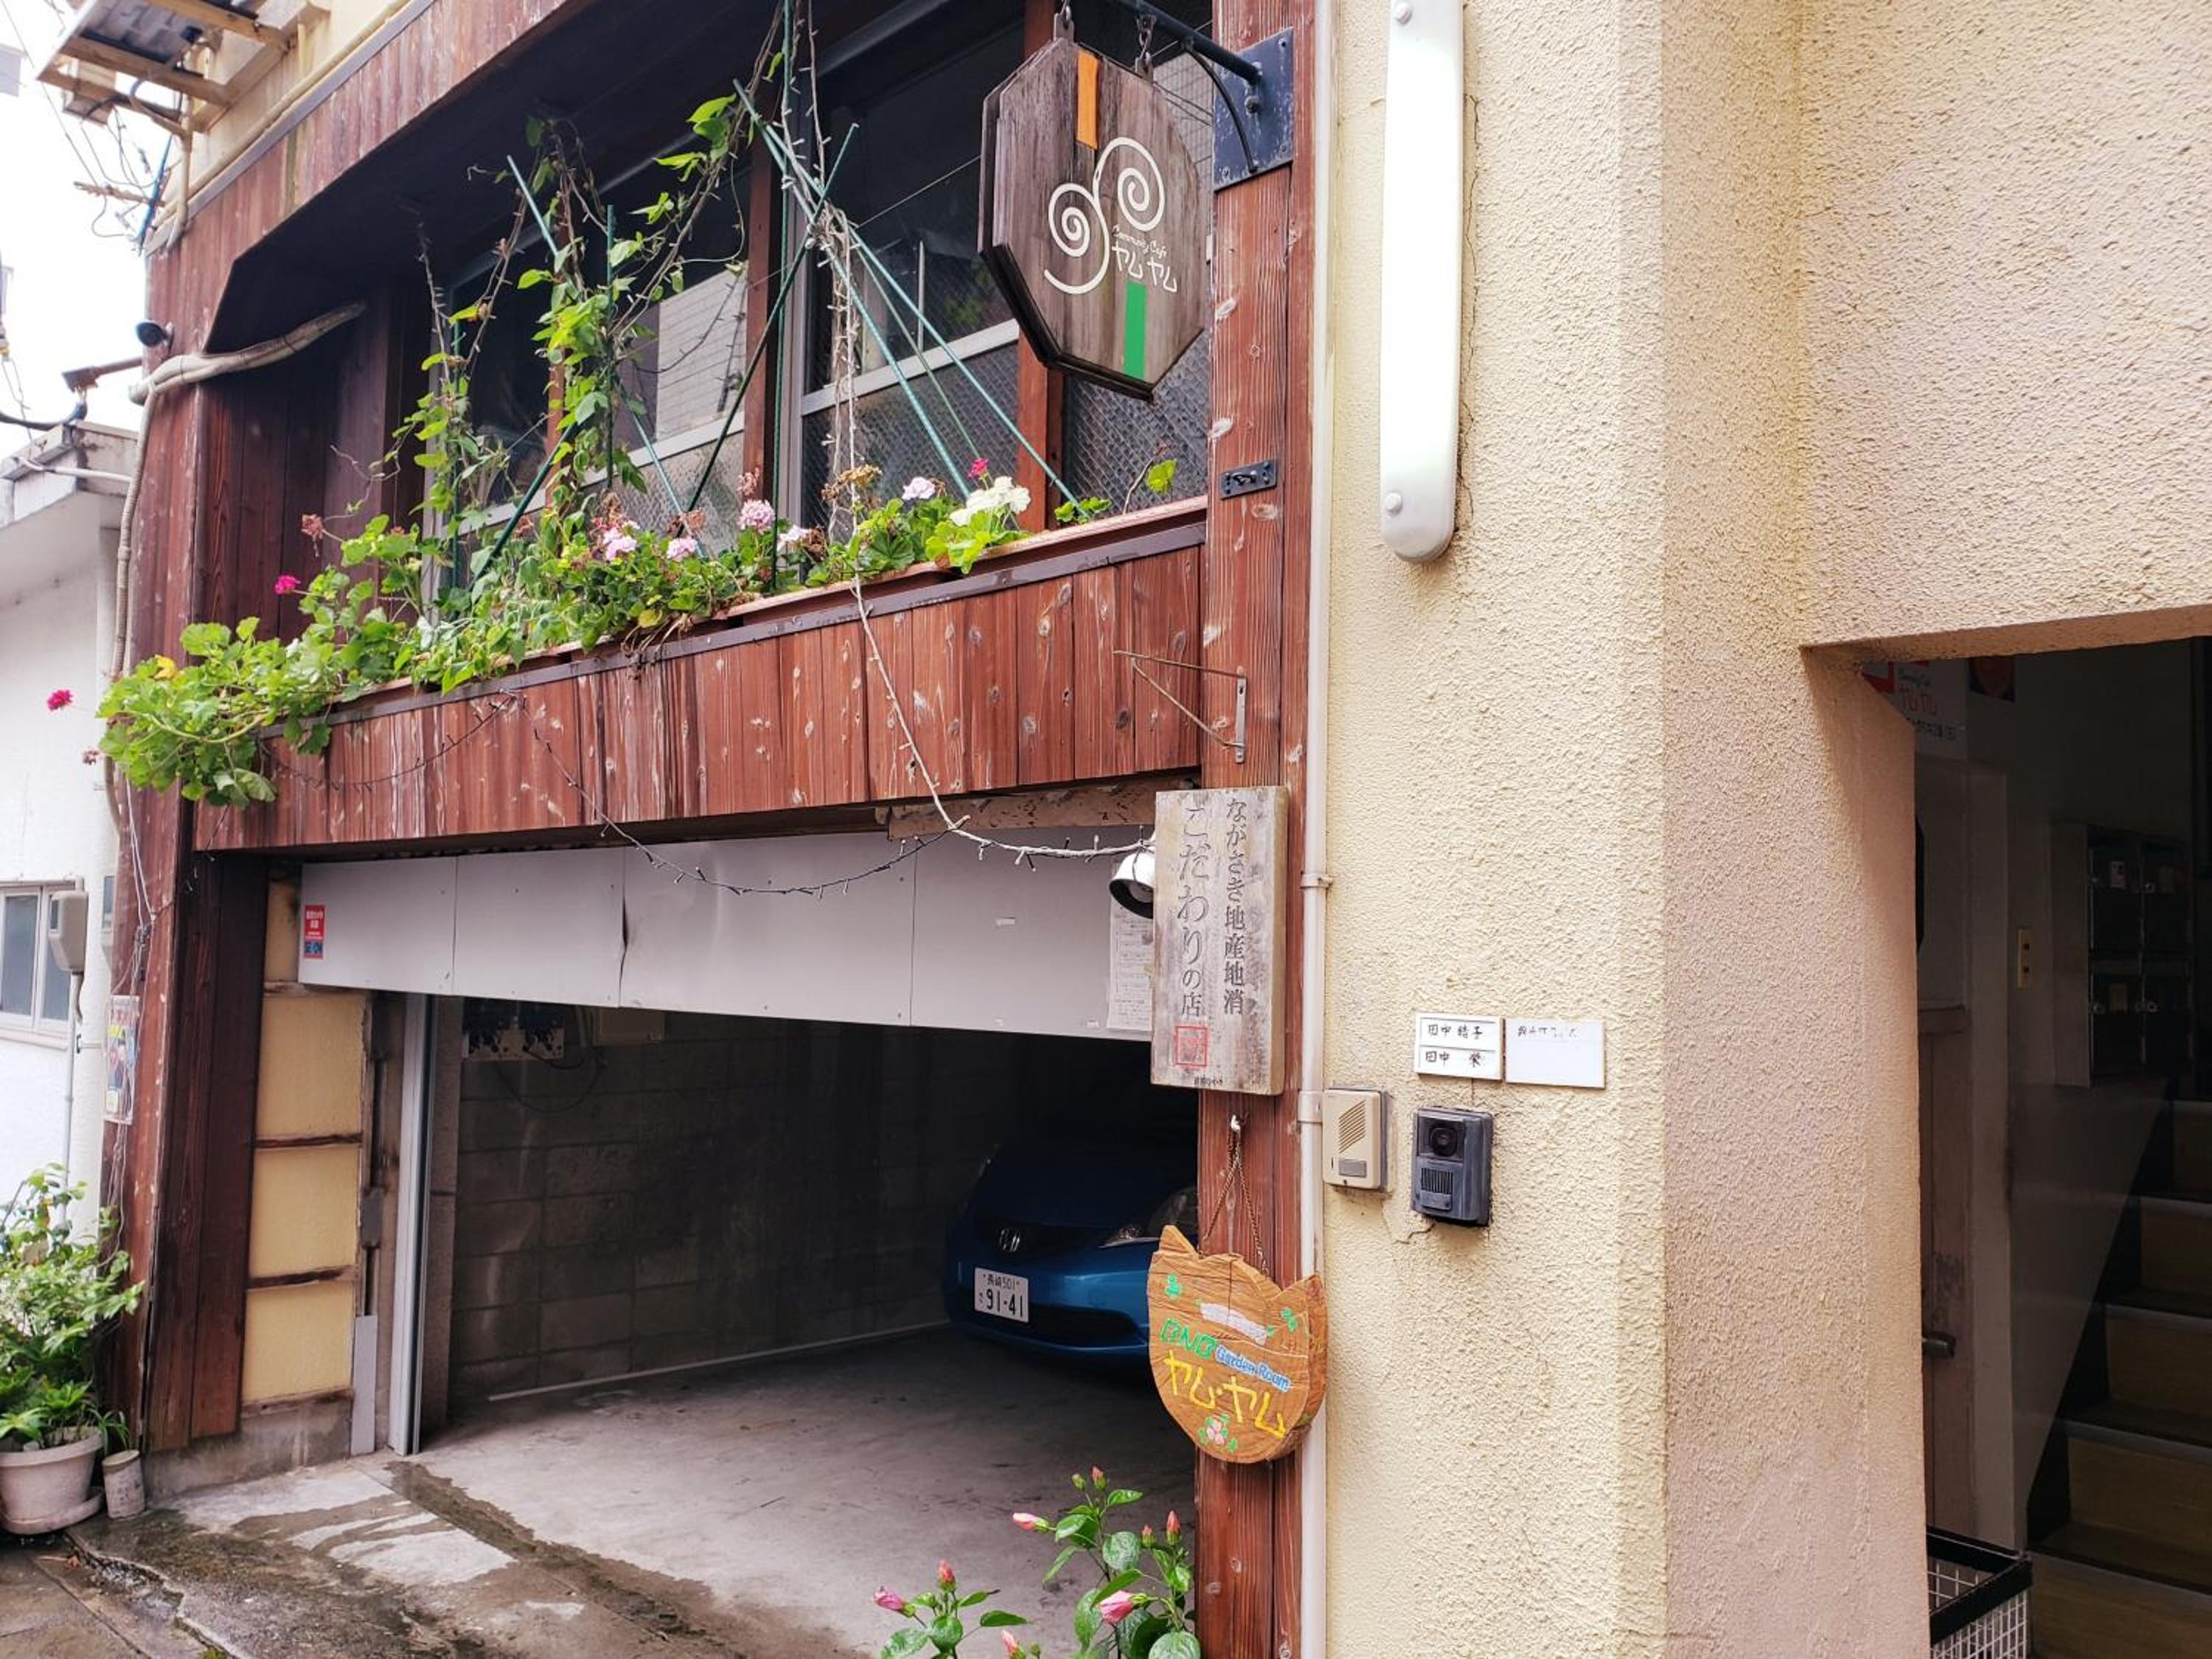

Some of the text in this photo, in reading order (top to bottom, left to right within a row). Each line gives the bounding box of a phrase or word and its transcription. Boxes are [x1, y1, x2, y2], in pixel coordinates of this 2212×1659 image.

[1178, 807, 1211, 1018] こだわりの店
[1224, 799, 1246, 1015] ながさき地産地消
